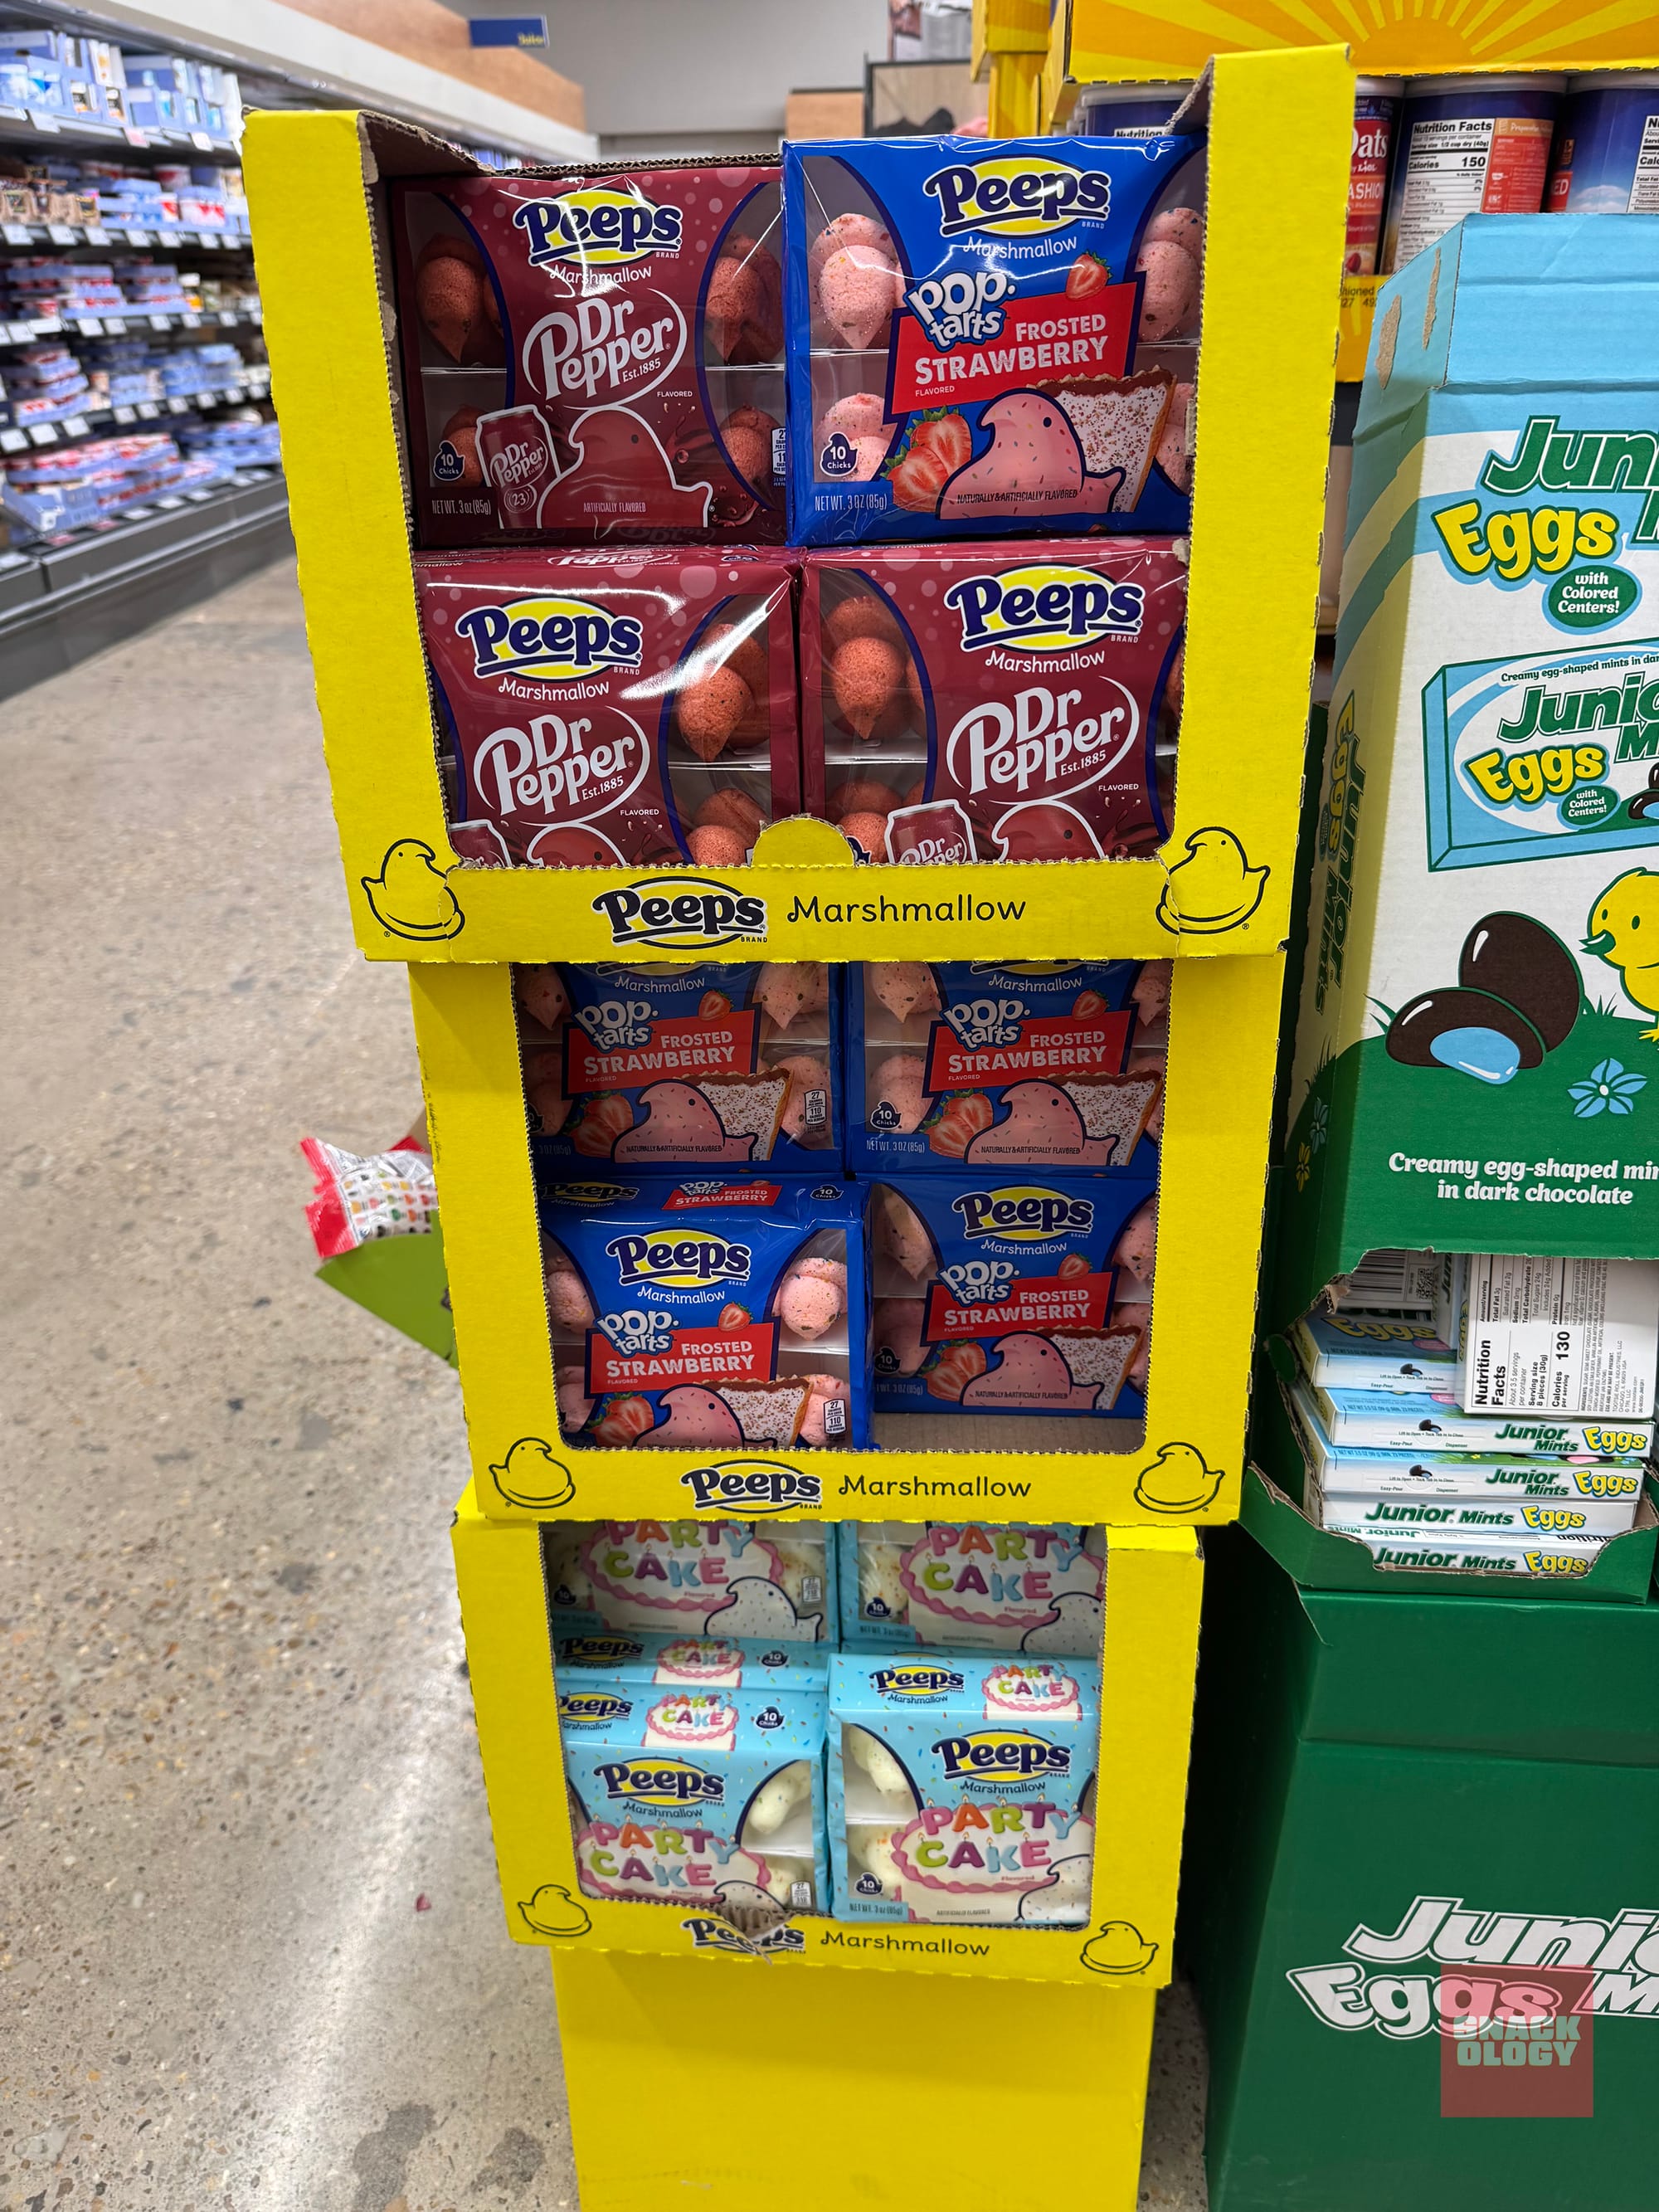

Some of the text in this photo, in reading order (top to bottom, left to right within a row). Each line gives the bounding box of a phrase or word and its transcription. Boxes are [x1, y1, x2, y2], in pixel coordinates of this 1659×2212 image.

[1413, 121, 1491, 134] Nutrition Facts
[1462, 157, 1486, 167] 150
[925, 170, 1110, 222] Peeps
[515, 204, 682, 253] Peeps
[963, 236, 1077, 260] Marshmallow
[550, 266, 652, 285] Marshmallow
[577, 298, 634, 345] Dr
[930, 308, 1002, 346] tarts
[1016, 314, 1106, 342] FROSTED
[530, 312, 674, 400] Pepper
[915, 336, 1108, 385] STRAWBERRY
[915, 387, 955, 397] FLAVORED
[441, 454, 454, 466] 10
[830, 446, 846, 460] 10
[584, 502, 646, 513] ARTIFICIALLY FLAVORED
[815, 494, 888, 511] NET 3 (85g)
[1045, 490, 1078, 500] FLAVORED
[1432, 499, 1620, 582] Eggs
[1575, 572, 1609, 585] with
[1562, 585, 1618, 600] Colored
[946, 578, 1145, 636] Peeps
[1558, 599, 1620, 614] Centers!
[458, 609, 642, 665] Peeps
[1111, 635, 1139, 644] BRAND
[614, 666, 640, 675] BRAND
[985, 650, 1105, 674] Marshmallow
[1501, 655, 1641, 683] Creamy egg-shaped mints in
[499, 678, 610, 701] Marshmallow
[1014, 688, 1082, 743] Dr
[528, 714, 591, 767] Dr
[961, 703, 1126, 795] Pepper
[484, 728, 635, 816] Pepper
[1328, 690, 1355, 854] Eggs
[1465, 744, 1607, 805] Eggs
[1098, 783, 1139, 792] FLAVORED
[1576, 789, 1598, 799] with
[1568, 805, 1607, 817] Centers!
[1569, 797, 1605, 809] Colored
[1329, 733, 1366, 989] Junior
[592, 890, 1027, 936] Peeps Marshmallow
[615, 976, 705, 994] Marshmallow
[989, 975, 1082, 992] Marshmallow
[593, 1022, 649, 1051] tarts
[661, 1030, 732, 1048] FROSTED
[960, 1023, 1020, 1049] tarts
[1030, 1031, 1105, 1047] FROSTED
[583, 1046, 735, 1075] STRAWBERRY
[948, 1045, 1107, 1073] STRAWBERRY
[879, 1110, 892, 1119] 10
[1389, 1152, 1618, 1183] Creamy egg-shaped
[676, 1195, 767, 1205] STRAWBERRY
[1438, 1179, 1633, 1204] in dark chocolate
[953, 1196, 1093, 1232] Peeps
[607, 1236, 750, 1277] Peeps
[980, 1239, 1067, 1255] Marshmallow
[637, 1286, 725, 1303] Marshmallow
[956, 1284, 1010, 1303] tarts
[1019, 1290, 1088, 1303] FROSTED
[1523, 1266, 1531, 1307] Carbohydrate
[1533, 1284, 1541, 1303] Sugars
[1480, 1280, 1488, 1322] Amount/serving
[944, 1303, 1090, 1325] STRAWBERRY
[1322, 1318, 1437, 1341] Eggs
[615, 1331, 670, 1354] tarts
[682, 1341, 752, 1356] FROSTED
[606, 1355, 754, 1377] STRAWBERRY
[880, 1355, 893, 1365] 10
[1475, 1340, 1491, 1405] Nutrition
[1552, 1331, 1570, 1406] Calories 130
[1491, 1366, 1506, 1406] Facts
[1509, 1352, 1520, 1406] About servings
[1529, 1362, 1539, 1406] Serving size
[1538, 1354, 1548, 1399] pieces (30g)
[1494, 1423, 1647, 1453] Junior Eggs
[1534, 1439, 1579, 1452] Mints
[681, 1469, 1031, 1503] Peeps Marshmallow
[1486, 1469, 1638, 1497] Junior Eggs
[1525, 1484, 1569, 1495] Mints
[1365, 1503, 1586, 1531] Junior Mints Eggs
[605, 1520, 753, 1557] PARTY
[928, 1525, 1083, 1572] PARTY
[604, 1552, 729, 1587] CAKE
[1374, 1547, 1588, 1574] Junior Mints Eggs
[923, 1562, 1053, 1602] CAKE
[869, 1669, 964, 1689] Peeps
[992, 1664, 1067, 1682] PARTY
[888, 1693, 948, 1705] Marshmallow
[998, 1680, 1065, 1698] CAKE
[662, 1709, 725, 1727] CAKE
[763, 1712, 777, 1721] 10
[932, 1738, 1071, 1774] Peeps
[594, 1763, 724, 1800] Peeps
[960, 1781, 1046, 1795] Marshmallow
[623, 1801, 703, 1819] Marshmallow
[921, 1803, 1079, 1840] PARTY
[590, 1822, 740, 1864] PARTY
[590, 1850, 717, 1888] CAKE
[916, 1840, 1052, 1873] CAKE
[862, 1880, 874, 1889] 10
[820, 1931, 990, 1956] Marshmallow
[1286, 1962, 1563, 2039] Eggs
